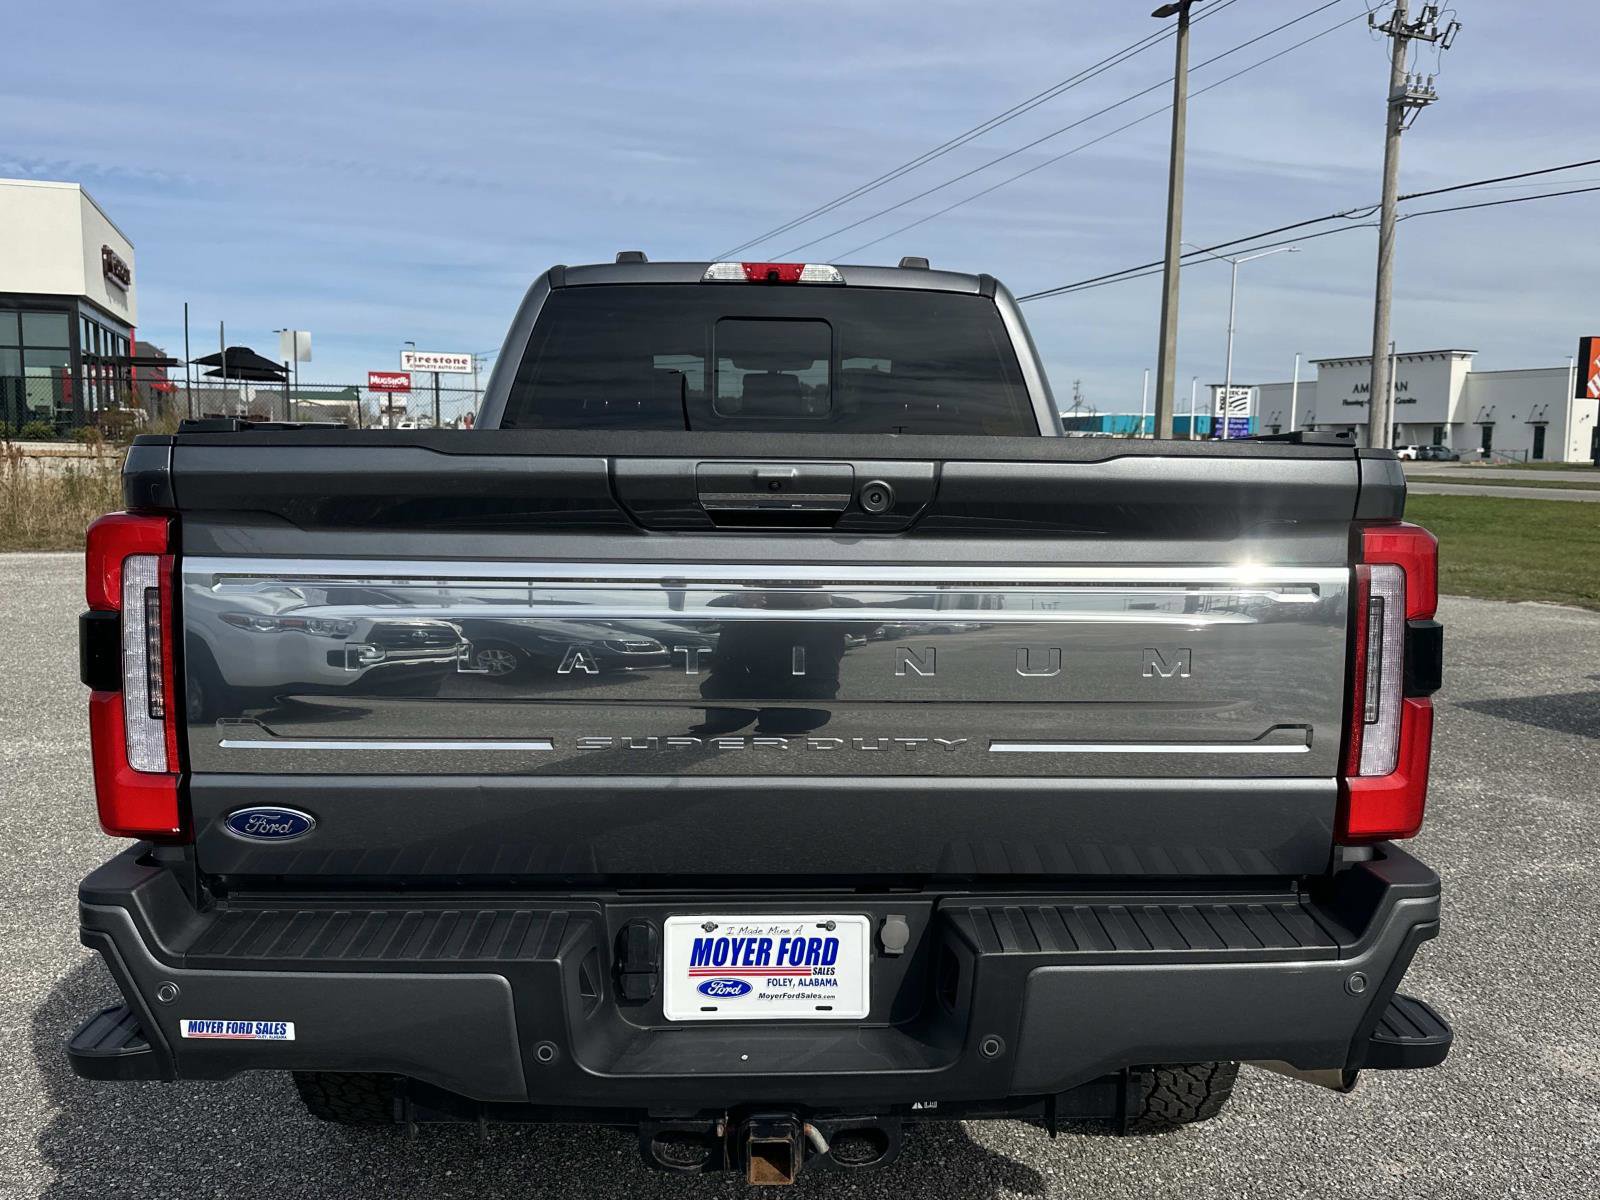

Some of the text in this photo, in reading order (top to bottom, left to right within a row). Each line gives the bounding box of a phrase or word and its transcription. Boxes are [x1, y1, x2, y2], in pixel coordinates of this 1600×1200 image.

[405, 355, 468, 365] Firestone
[1352, 381, 1409, 394] AMAN
[344, 641, 1193, 679] PLATINUM
[575, 735, 968, 753] SUPER DUTY
[245, 813, 294, 834] Ford
[726, 924, 804, 935] I Made Mine A
[690, 937, 839, 967] MOYER FORD
[812, 967, 835, 976] SALES
[706, 981, 742, 996] Ford
[767, 978, 838, 988] FOLEY, ALABAMA
[758, 992, 836, 1001] MoyerFordSales.com
[188, 1020, 287, 1036] MOYER FORD SALES
